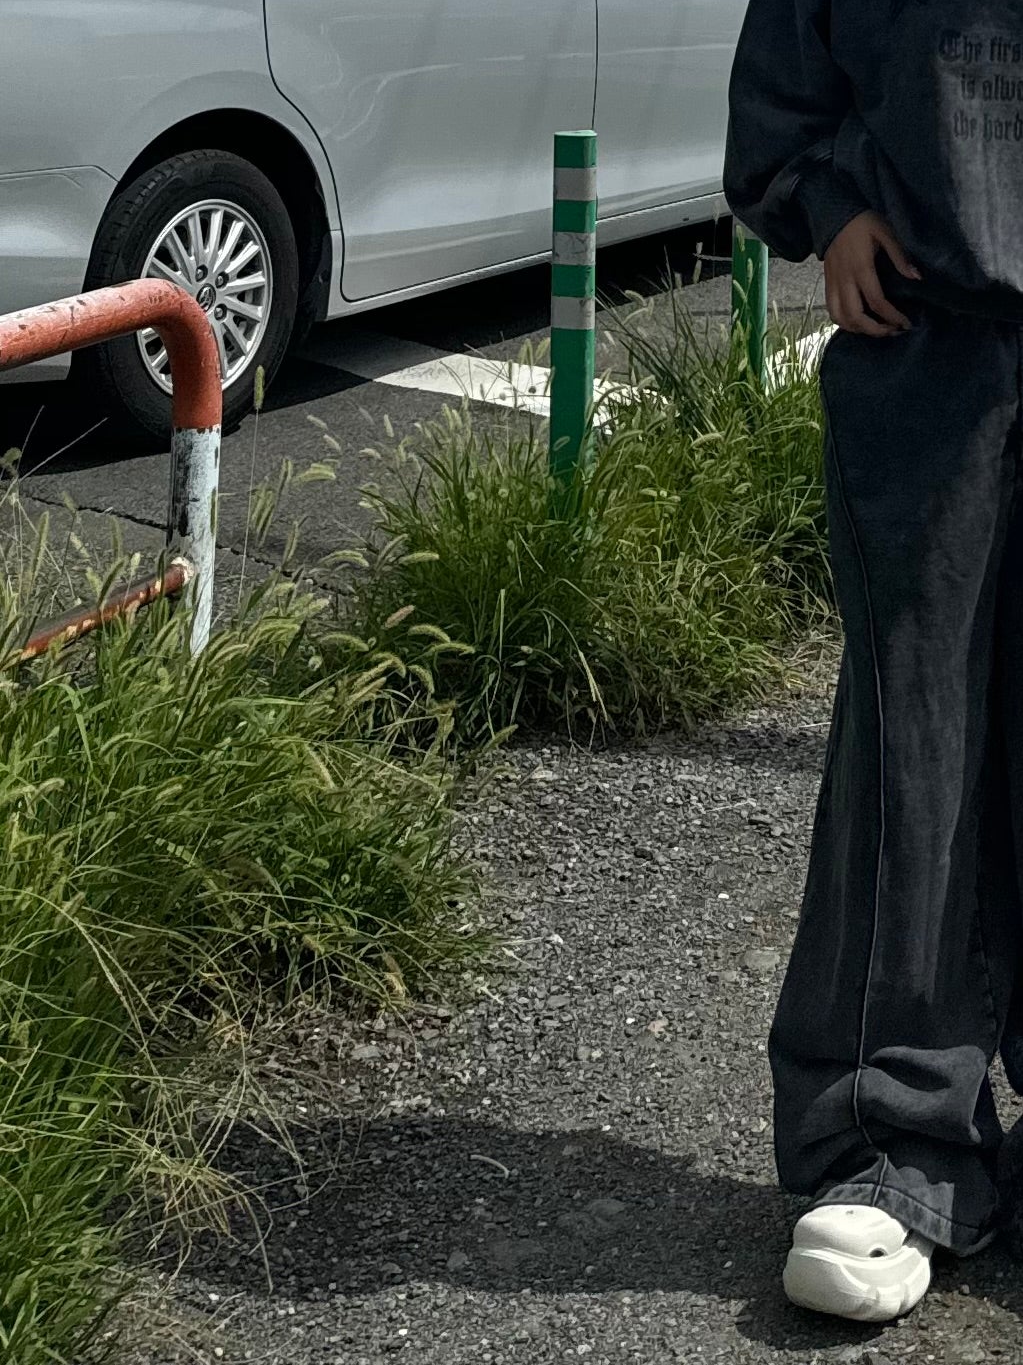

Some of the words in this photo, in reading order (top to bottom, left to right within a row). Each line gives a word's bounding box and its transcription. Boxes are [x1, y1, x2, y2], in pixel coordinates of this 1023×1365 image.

[938, 29, 981, 64] The
[960, 73, 976, 97] is
[953, 111, 976, 139] the
